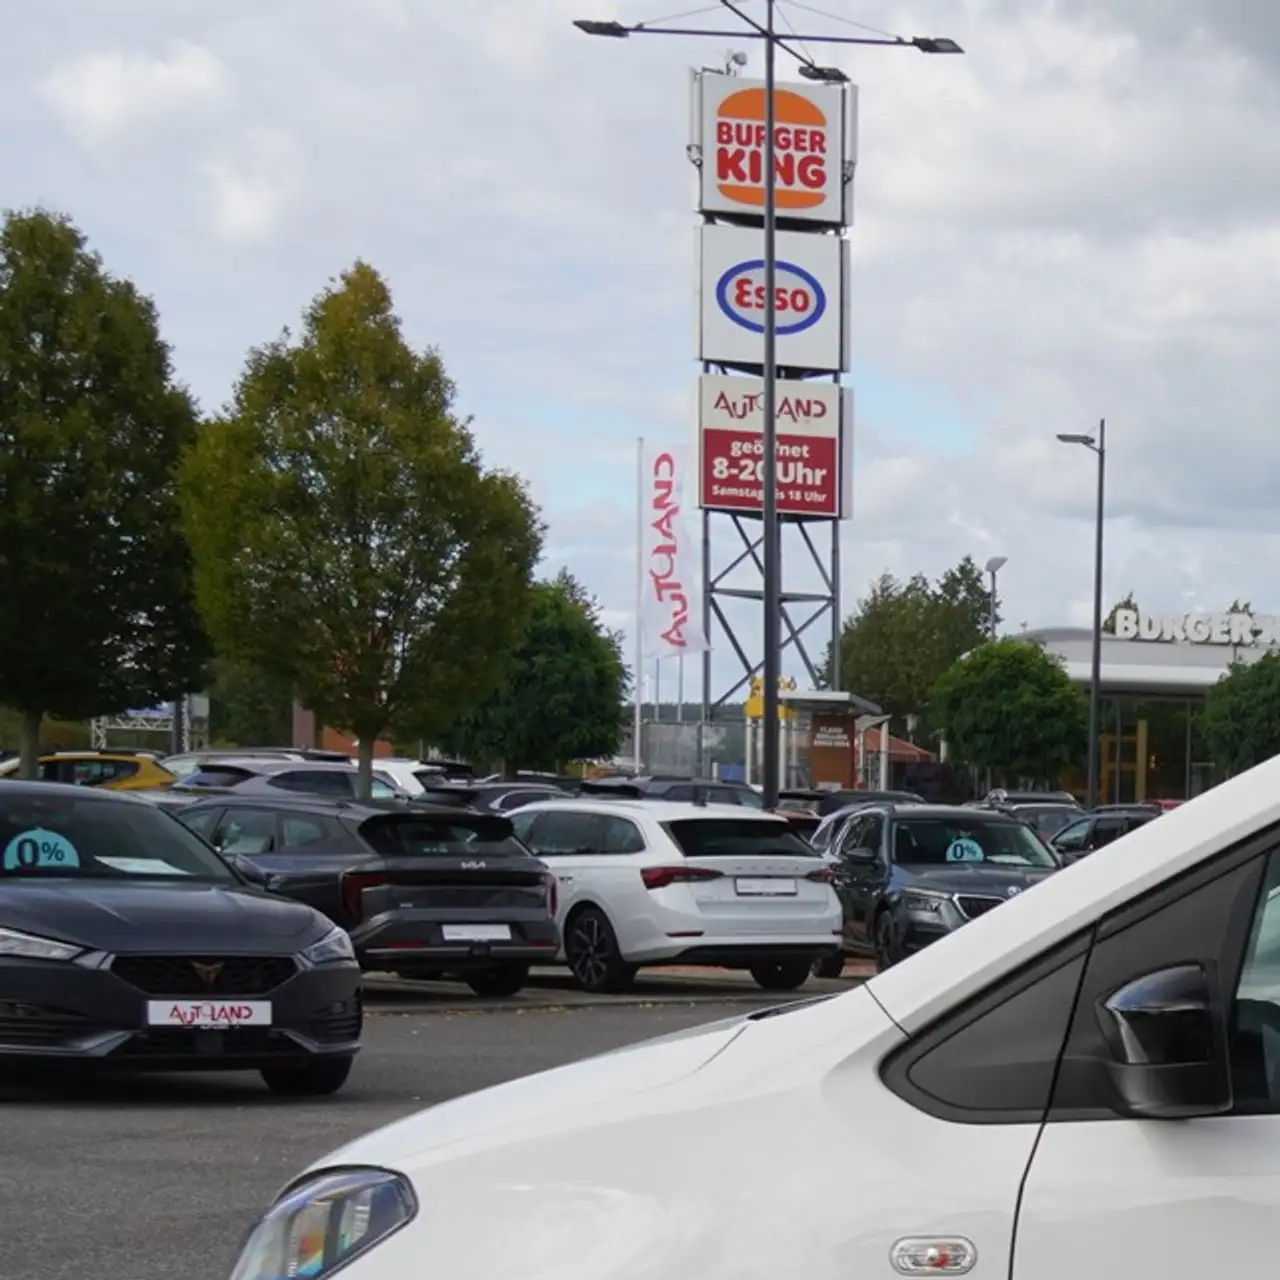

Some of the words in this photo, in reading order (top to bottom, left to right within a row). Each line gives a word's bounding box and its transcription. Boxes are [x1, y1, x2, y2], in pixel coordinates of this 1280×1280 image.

[717, 121, 826, 153] BURGER
[717, 147, 827, 189] KING
[775, 462, 827, 485] Uhr
[650, 453, 688, 647] AUTOLAND
[1115, 608, 1253, 644] BURGER
[17, 838, 65, 868] 0%
[169, 1001, 253, 1025] AUTOLAND
